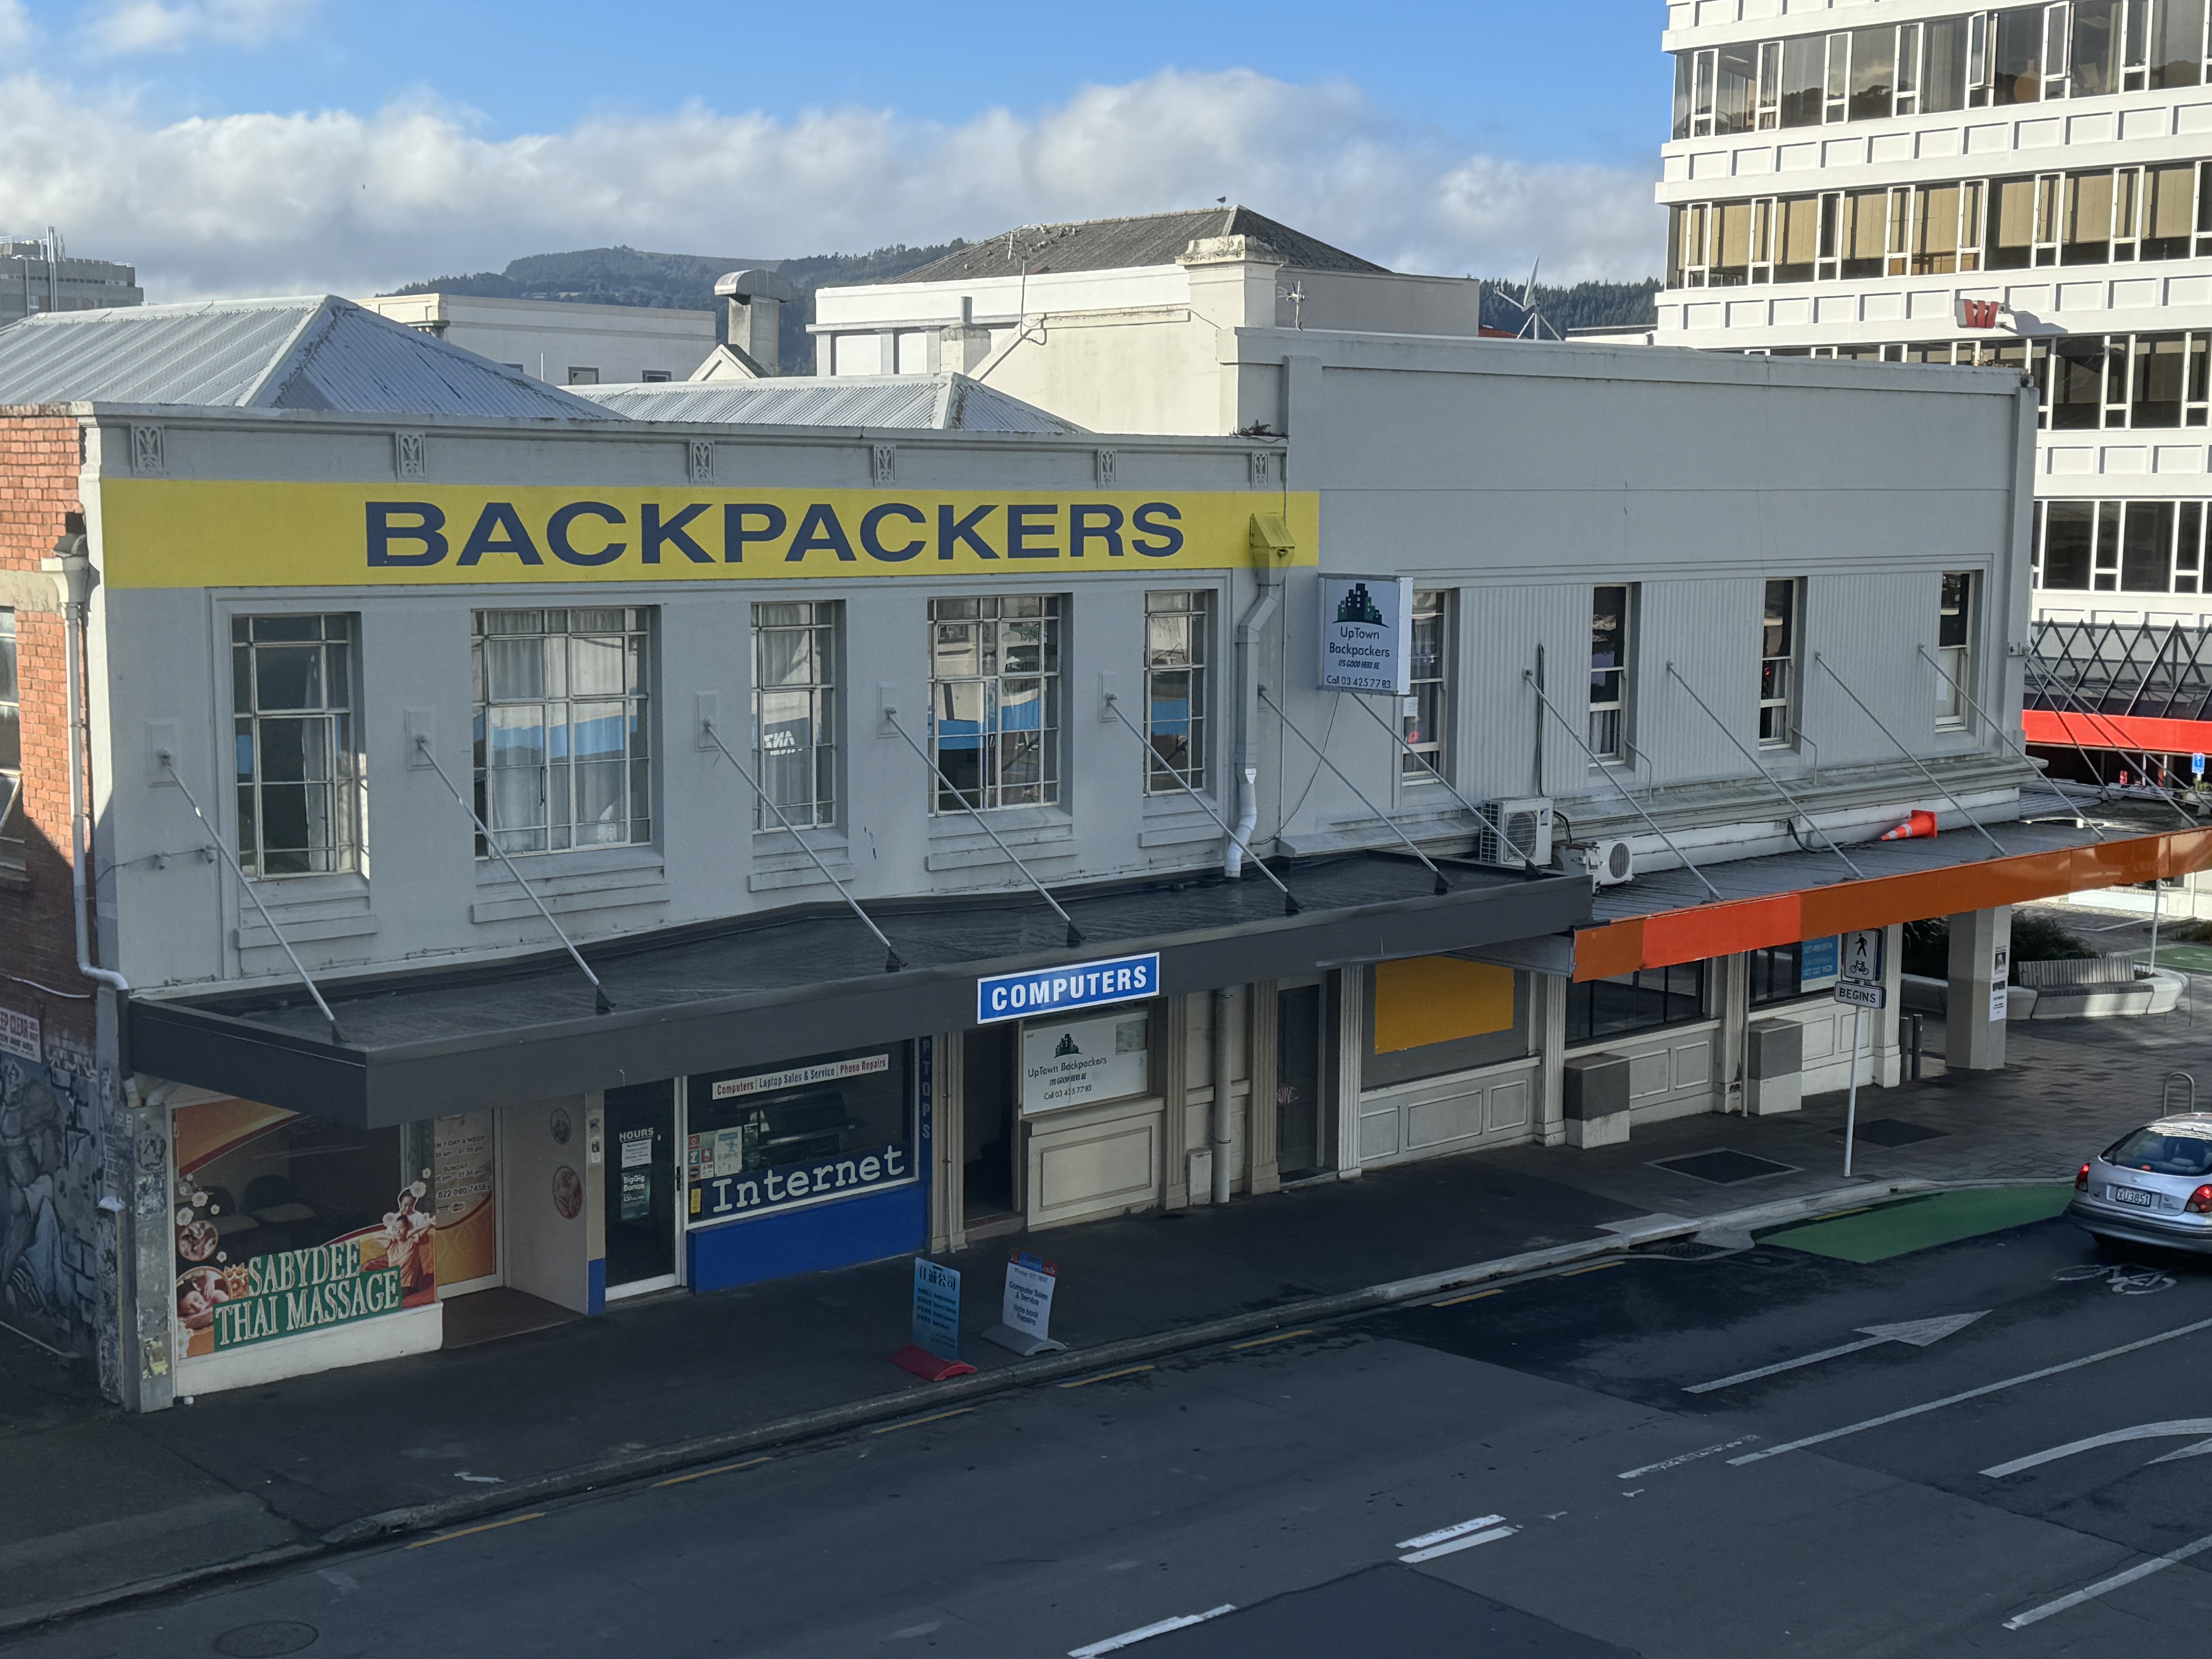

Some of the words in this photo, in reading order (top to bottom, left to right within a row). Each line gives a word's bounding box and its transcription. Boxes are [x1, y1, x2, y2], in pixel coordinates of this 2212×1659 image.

[365, 501, 1184, 566] BACKPACKERS
[1340, 626, 1379, 641] UpTown
[1329, 642, 1390, 658] Backpackers
[1327, 675, 1339, 684] Call
[1341, 677, 1351, 685] 03
[1353, 677, 1368, 687] 425
[991, 965, 1147, 1011] COMPUTERS
[1839, 987, 1876, 1003] BEGINS
[717, 1081, 754, 1096] Computers
[759, 1077, 781, 1089] Laptop
[784, 1073, 802, 1082] Sales
[804, 1072, 809, 1080] &
[811, 1067, 835, 1079] Service
[840, 1063, 859, 1074] Phone
[862, 1059, 886, 1072] Repairs
[1028, 1066, 1058, 1079] UpTown
[1061, 1057, 1107, 1070] Backpackers
[619, 1128, 654, 1141] HOURS
[712, 1146, 905, 1212] Internet
[248, 1239, 360, 1297] SABYDEE
[215, 1293, 279, 1346] THAI
[287, 1270, 399, 1331] MASSAGE
